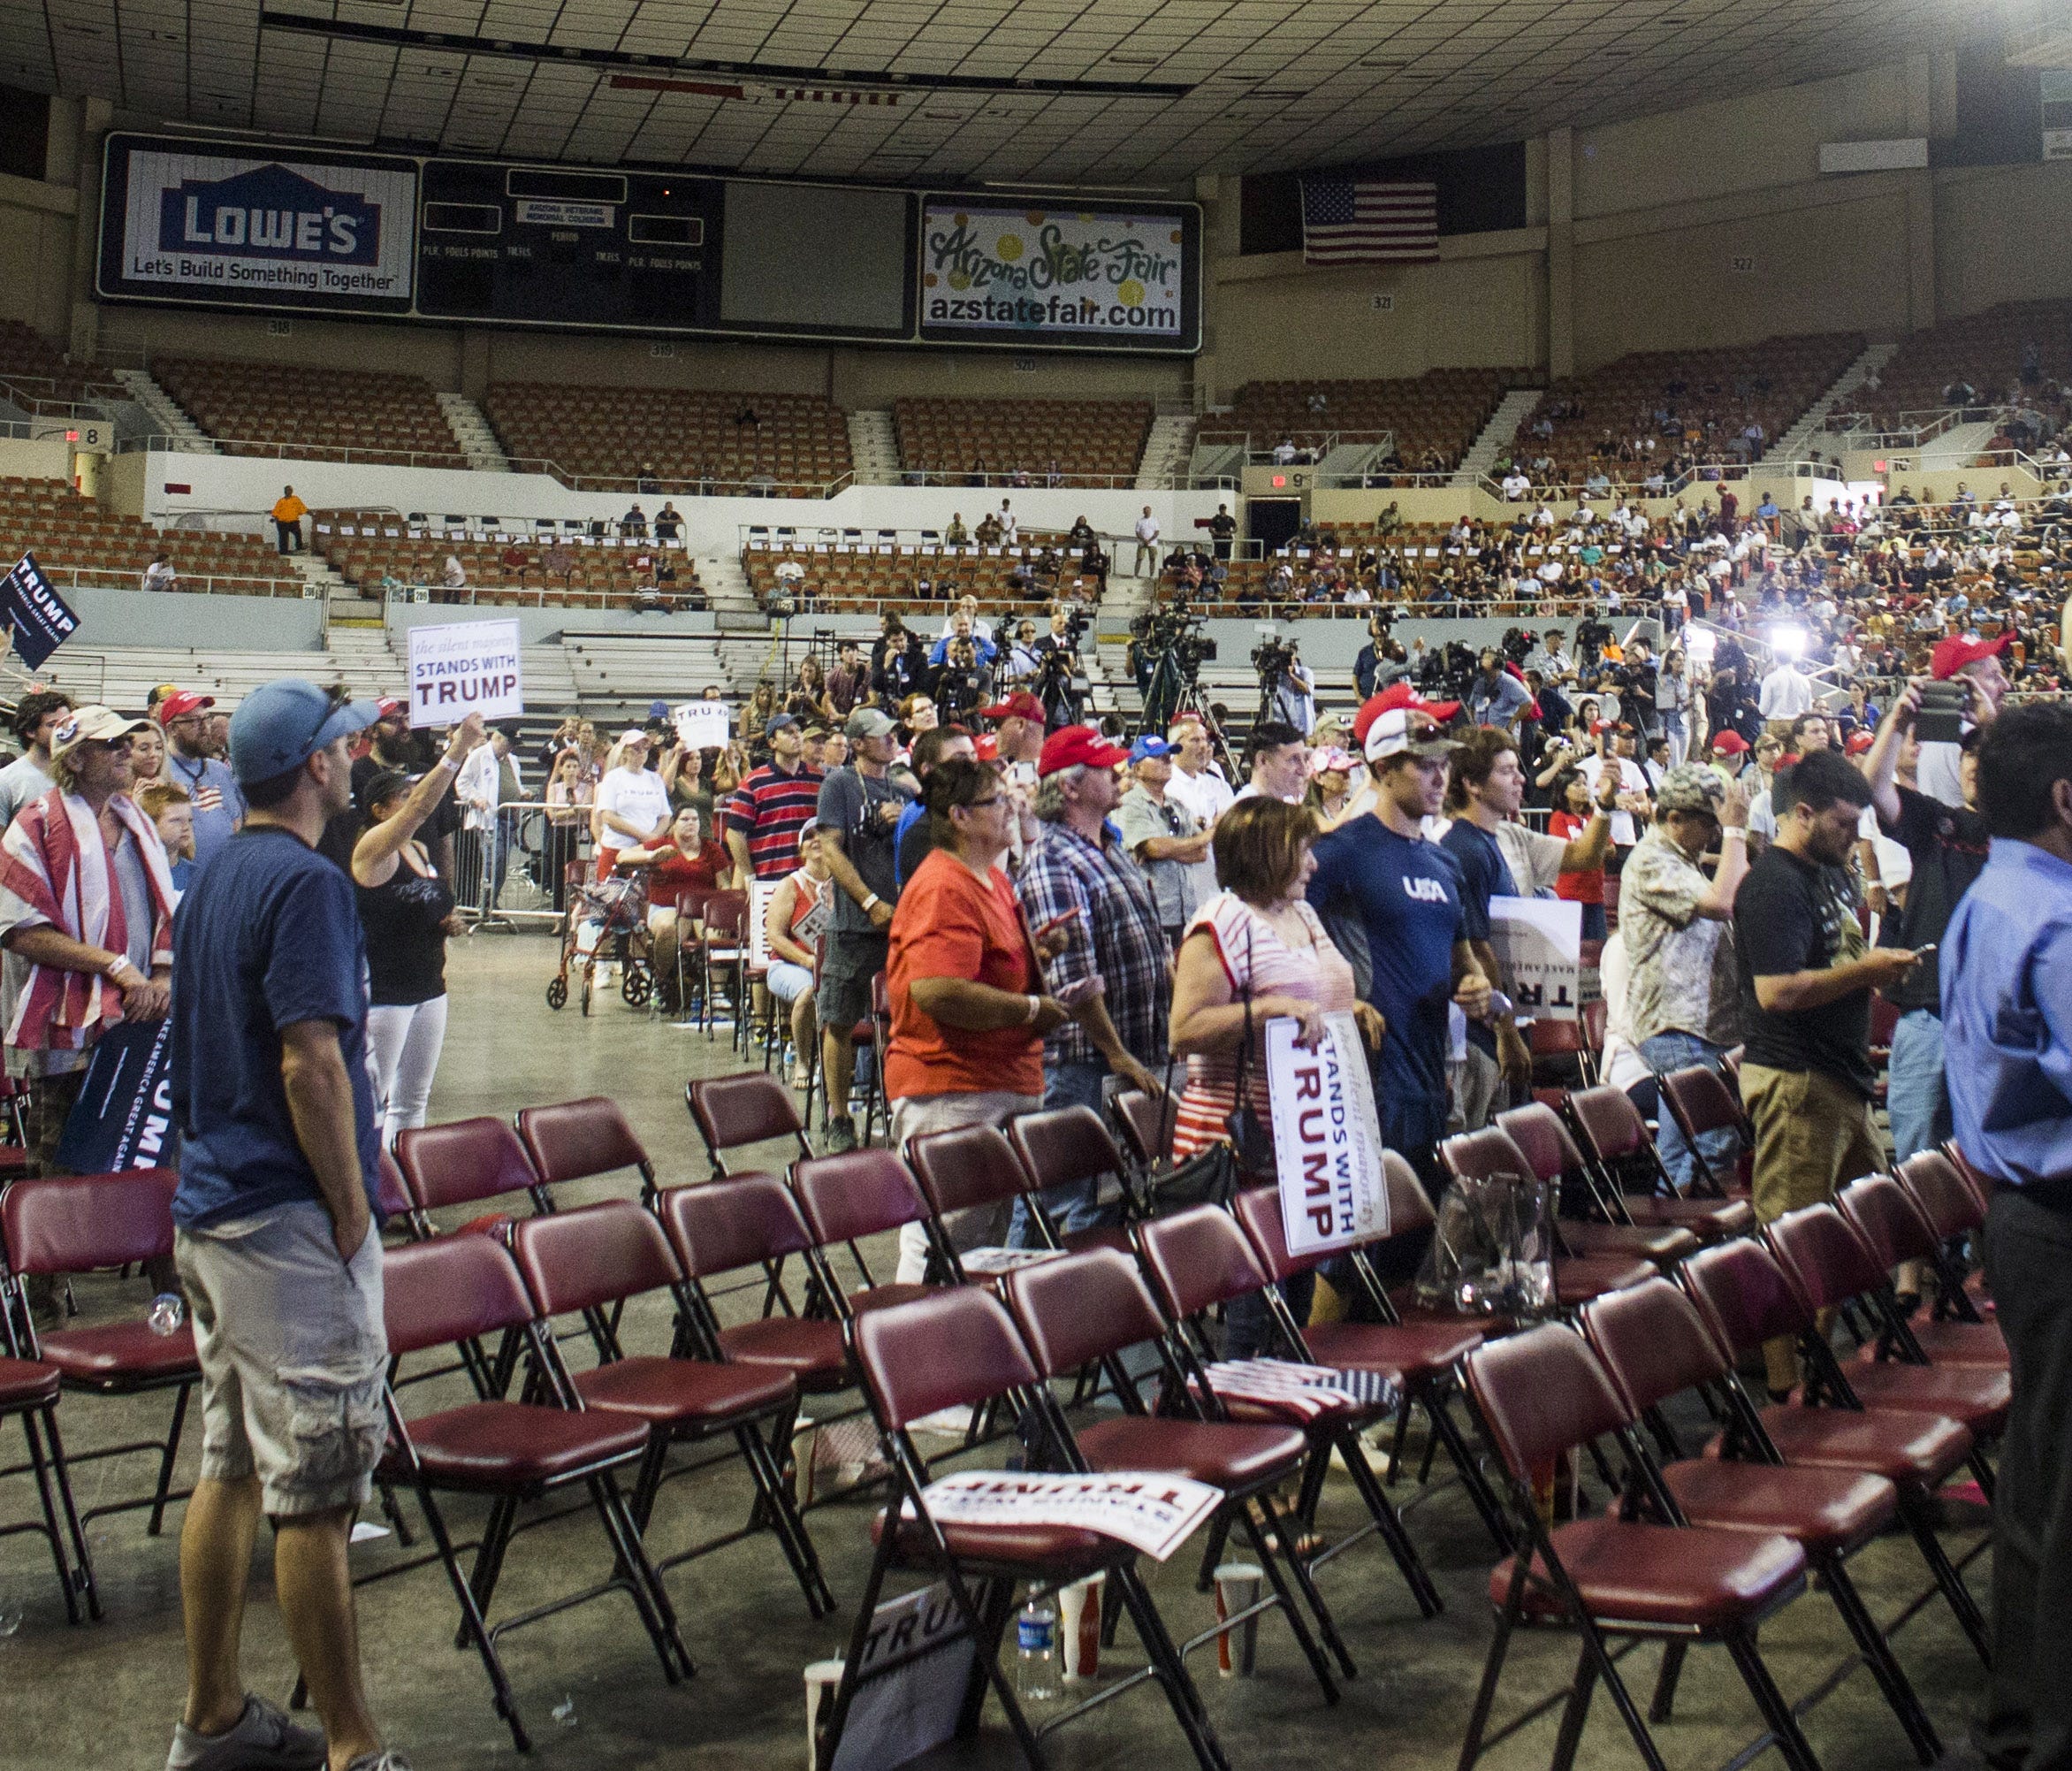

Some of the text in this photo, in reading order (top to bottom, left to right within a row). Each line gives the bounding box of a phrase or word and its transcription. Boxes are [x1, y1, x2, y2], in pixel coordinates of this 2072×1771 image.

[184, 195, 357, 255] LOWE'S
[133, 256, 394, 291] Let's Build Something Together
[929, 224, 1177, 290] Arizona State Fair
[930, 294, 1176, 328] azstatefair.com
[87, 429, 98, 444] 8
[1293, 473, 1303, 487] 9
[18, 558, 74, 632] TRUMP
[415, 640, 434, 655] the
[438, 637, 469, 653] silent
[416, 655, 516, 677] STANDS WITH
[416, 675, 516, 706] TRUMP
[1402, 875, 1449, 904] USA
[136, 1042, 164, 1094] AMERICA
[125, 1095, 144, 1134] GREAT
[1336, 1152, 1355, 1233] WITH
